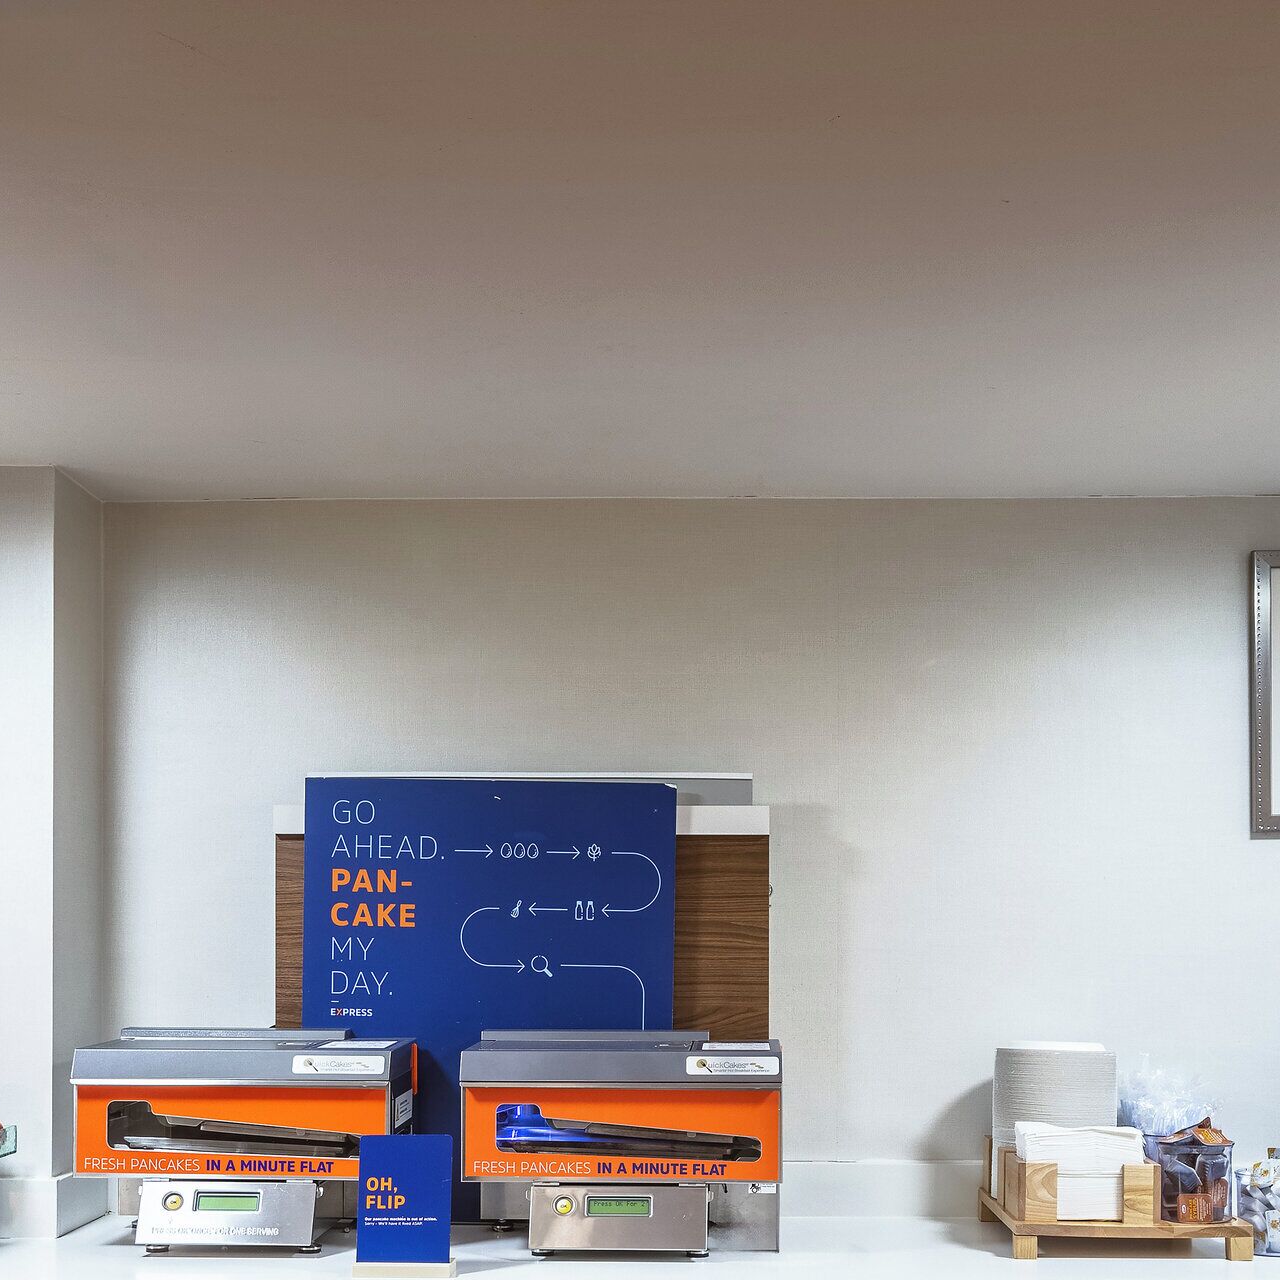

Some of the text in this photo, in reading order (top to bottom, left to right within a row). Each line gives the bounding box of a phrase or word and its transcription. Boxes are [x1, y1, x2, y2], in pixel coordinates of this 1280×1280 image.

[332, 799, 375, 825] GO
[330, 834, 445, 860] AHEAD.
[331, 867, 413, 893] PAN-
[330, 902, 416, 927] CAKE
[331, 936, 375, 961] MY
[330, 970, 393, 996] DAY.
[330, 1007, 373, 1017] EXPRESS
[84, 1157, 334, 1173] FRESH PANCAKES IN A MINUTE FLAT
[473, 1160, 727, 1176] FRESH PANCAKES IN A MINUTE FLAT
[366, 1177, 398, 1193] OH,
[365, 1195, 406, 1210] FLIP
[247, 1227, 280, 1236] SERVING
